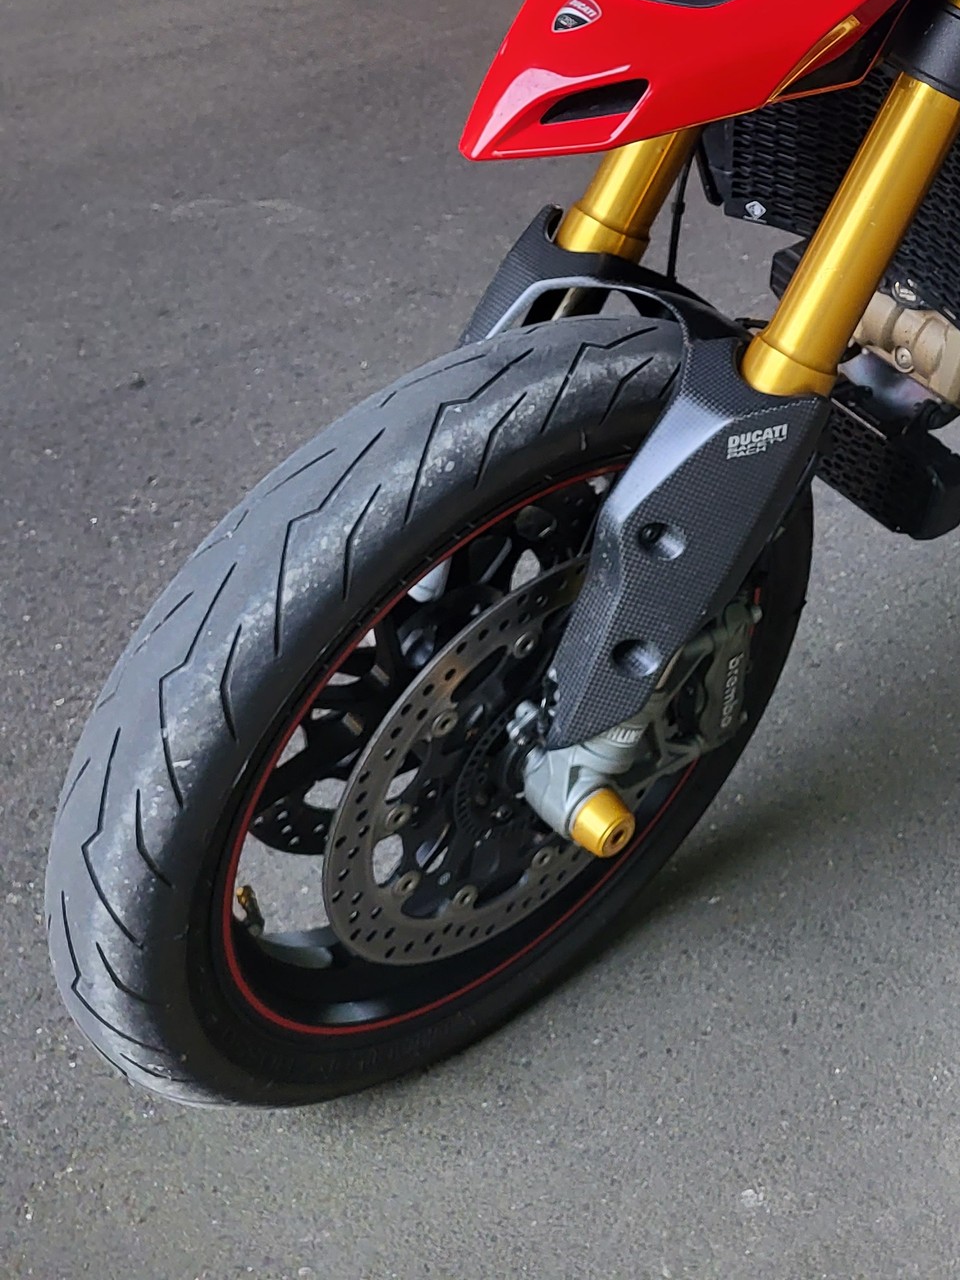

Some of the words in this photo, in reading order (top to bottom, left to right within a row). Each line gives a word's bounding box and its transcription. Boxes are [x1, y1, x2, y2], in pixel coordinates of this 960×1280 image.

[568, 0, 597, 18] DUCATI
[727, 423, 788, 449] DUCATI
[721, 652, 745, 728] brembo
